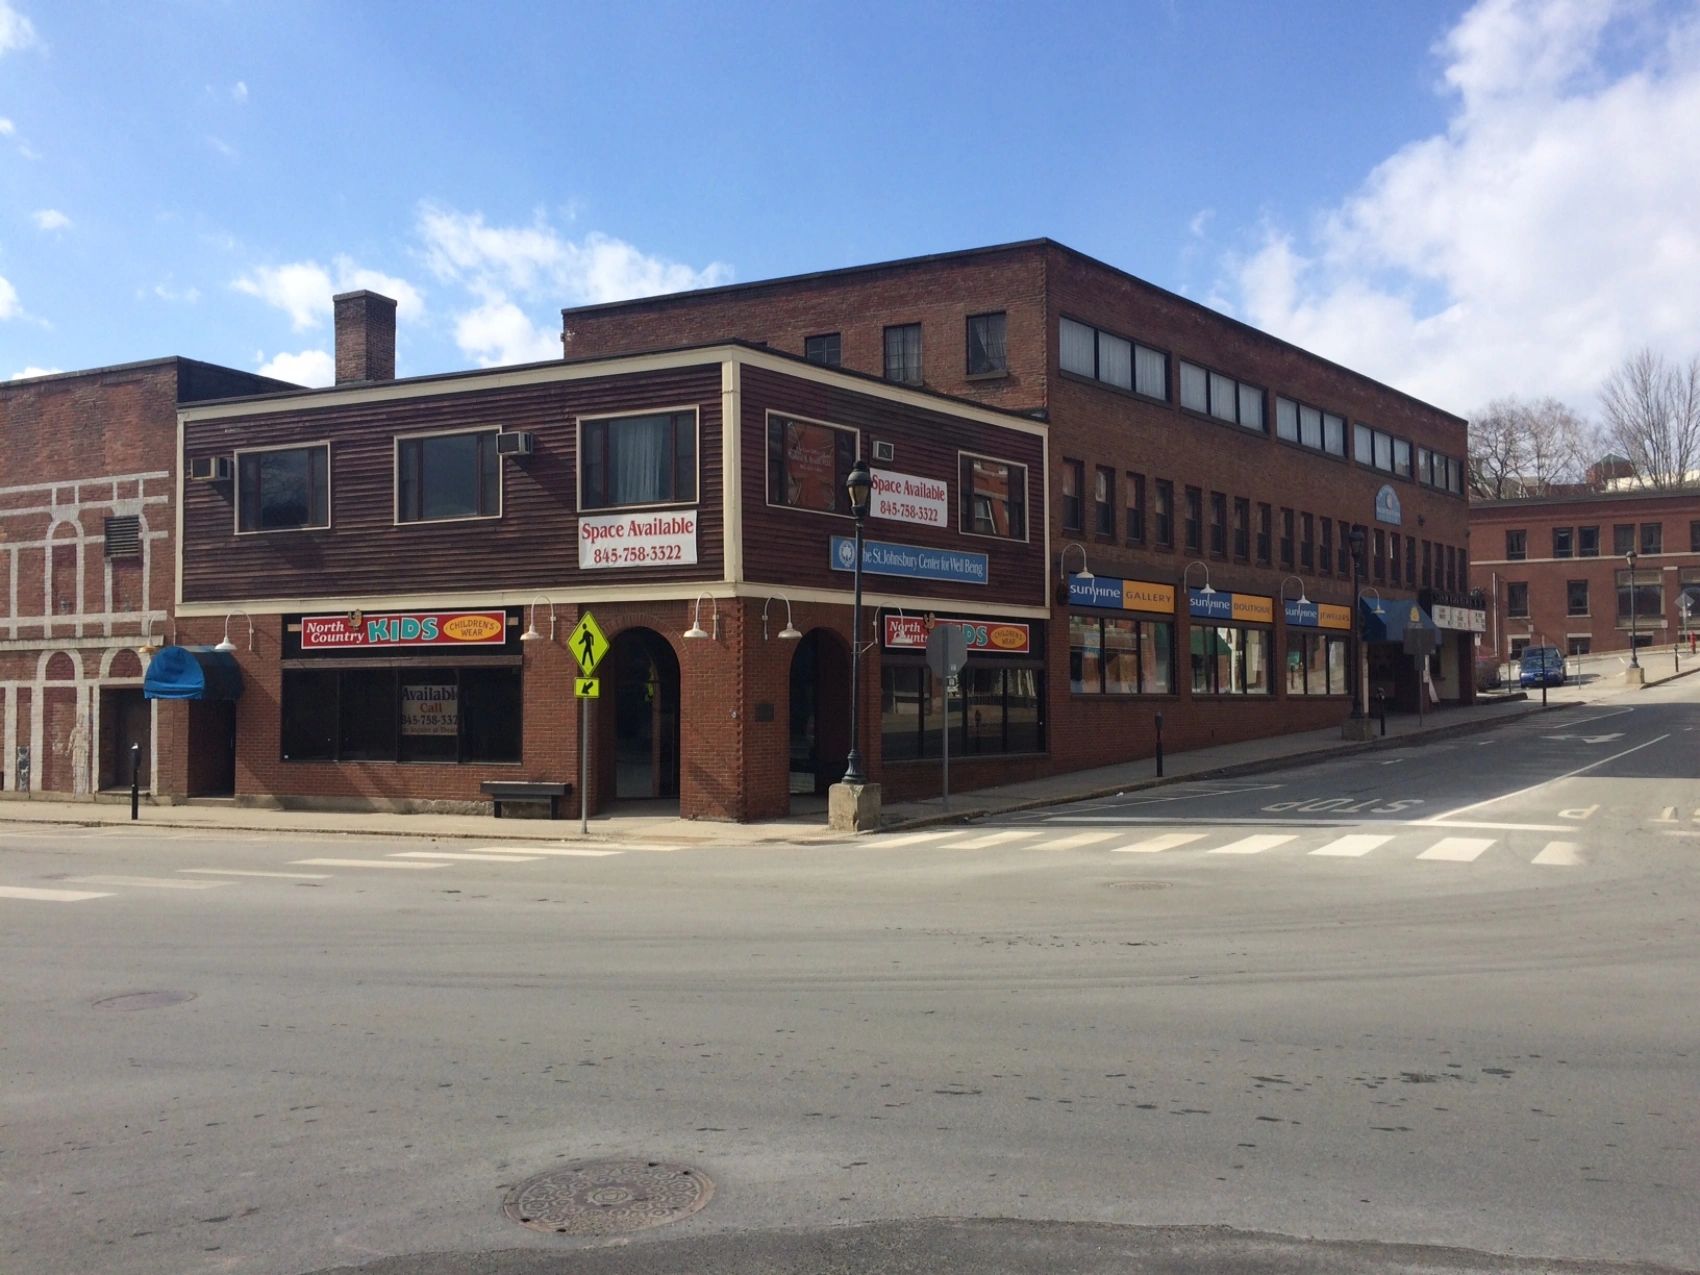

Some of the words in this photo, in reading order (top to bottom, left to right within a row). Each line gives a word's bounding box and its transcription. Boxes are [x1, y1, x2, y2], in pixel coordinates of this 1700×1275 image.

[872, 475, 901, 495] Space
[904, 480, 945, 501] Available
[582, 523, 624, 543] Space
[627, 517, 694, 536] Available
[919, 553, 940, 570] Center
[941, 556, 950, 571] for
[950, 557, 964, 573] Well
[965, 558, 983, 577] Being
[1126, 591, 1172, 603] GALLERY
[306, 621, 344, 633] North
[367, 617, 439, 643] KIDS
[449, 619, 496, 630] CHILDREN'S
[890, 621, 920, 632] North
[310, 630, 364, 644] Country
[420, 702, 442, 713] Call
[1260, 798, 1425, 814] STOP
